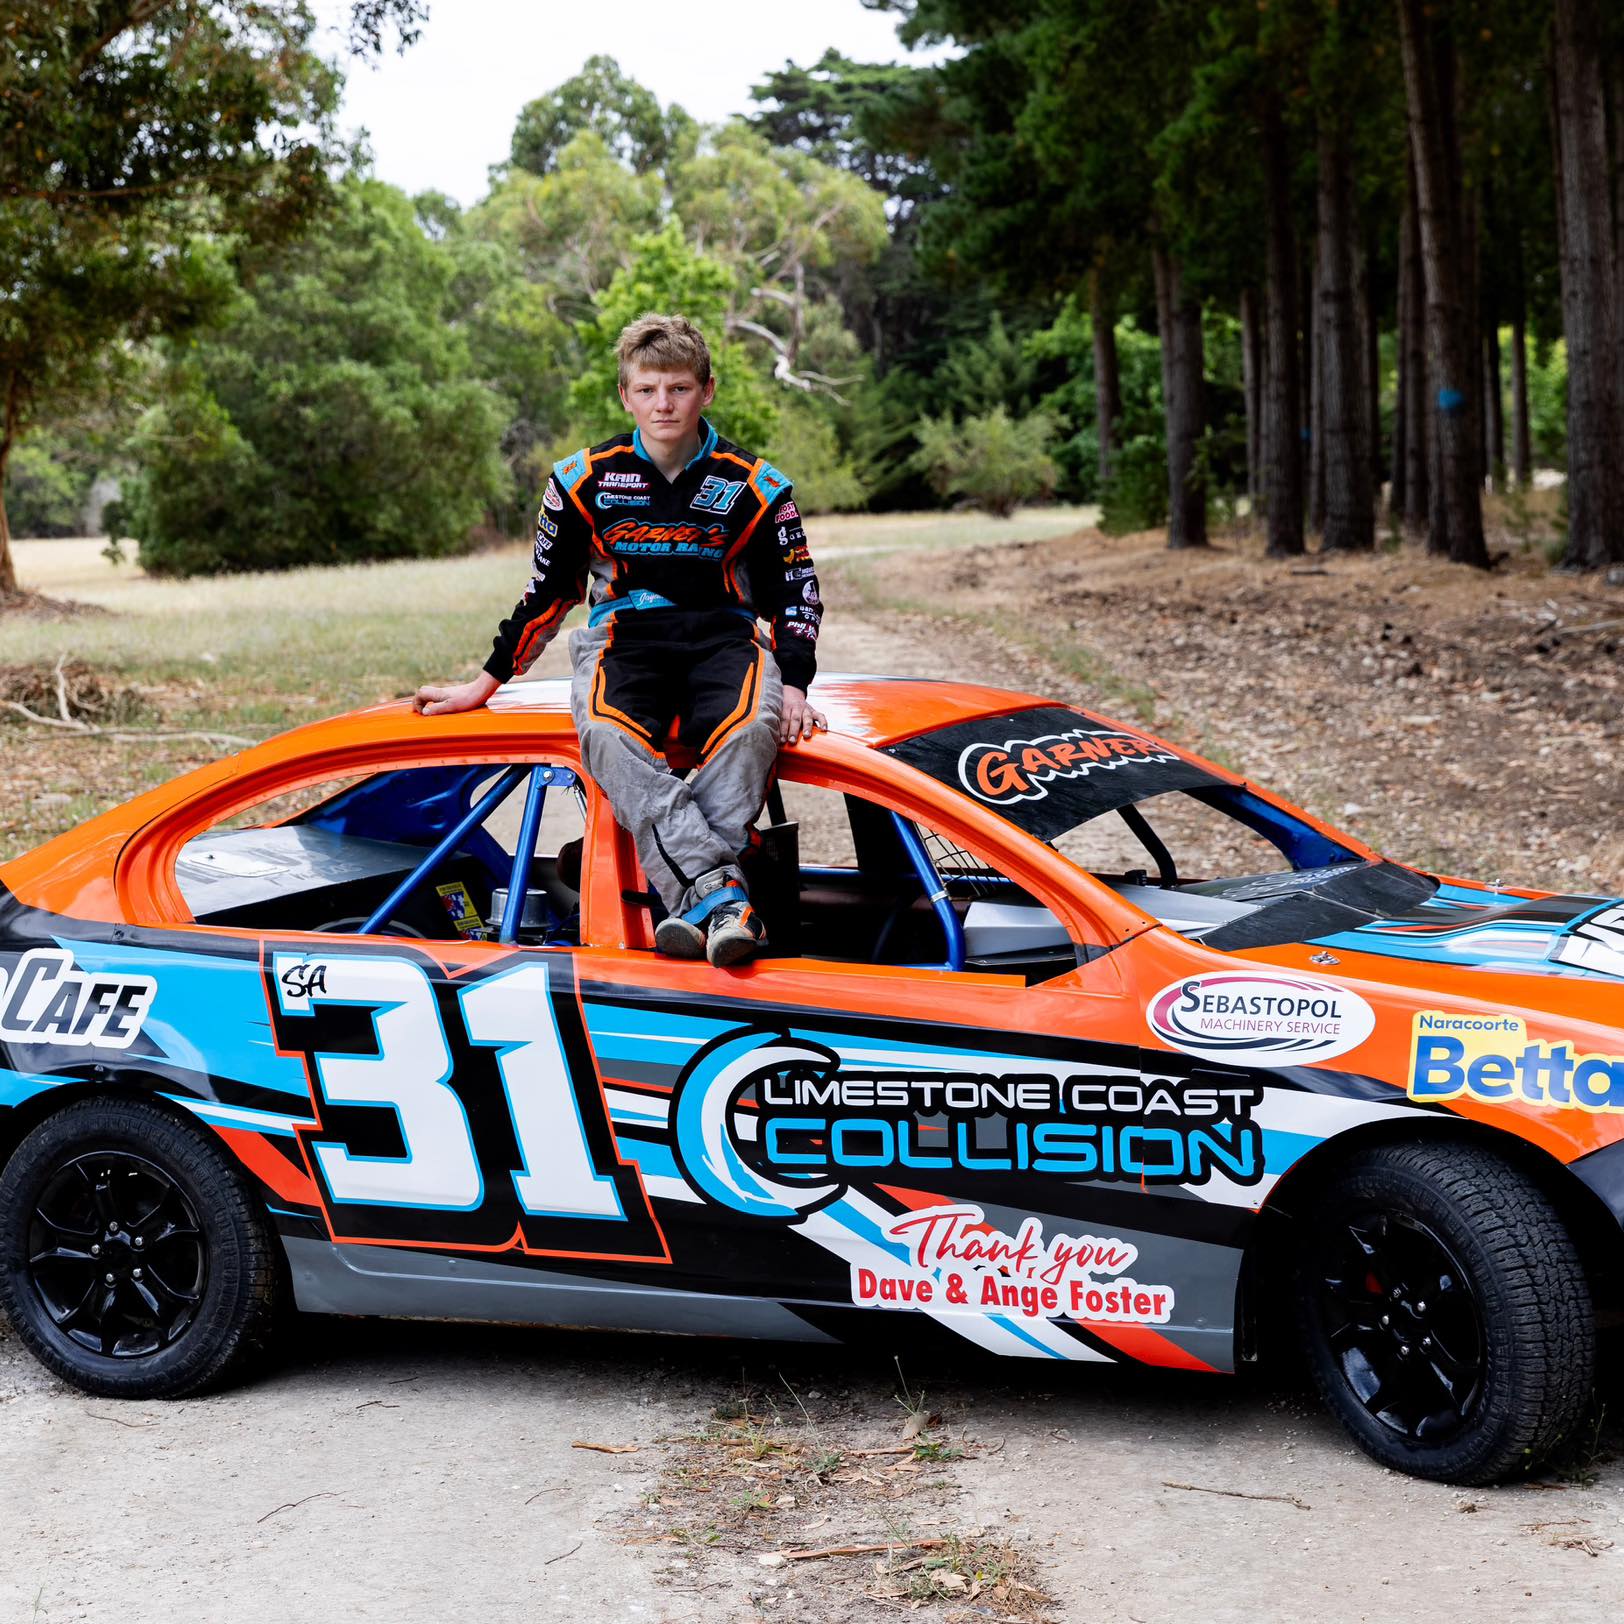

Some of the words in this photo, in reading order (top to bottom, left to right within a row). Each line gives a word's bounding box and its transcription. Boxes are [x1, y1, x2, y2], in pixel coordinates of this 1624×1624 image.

[598, 481, 648, 489] TRANSPORT
[691, 476, 747, 514] 31
[614, 541, 672, 552] MOTOR
[976, 736, 1156, 796] GARNER
[2, 957, 148, 1038] CAFE
[281, 963, 327, 998] SA
[1180, 981, 1342, 1020] SEBASTOPOL
[1200, 1017, 1282, 1033] MACHINERY
[1286, 1021, 1341, 1035] SERVICE
[1418, 1014, 1520, 1033] Naracoorte
[272, 952, 628, 1222] 31
[1413, 1036, 1624, 1107] Betta
[764, 1078, 1050, 1110] LIMESTONE
[1072, 1083, 1255, 1116] COAST
[765, 1117, 1255, 1177] COLLISION
[889, 1212, 1039, 1279] Thank
[1038, 1246, 1131, 1285] you
[858, 1268, 933, 1303] Dave
[946, 1274, 968, 1306] &
[980, 1275, 1058, 1317] Ange
[1069, 1280, 1167, 1317] Foster
